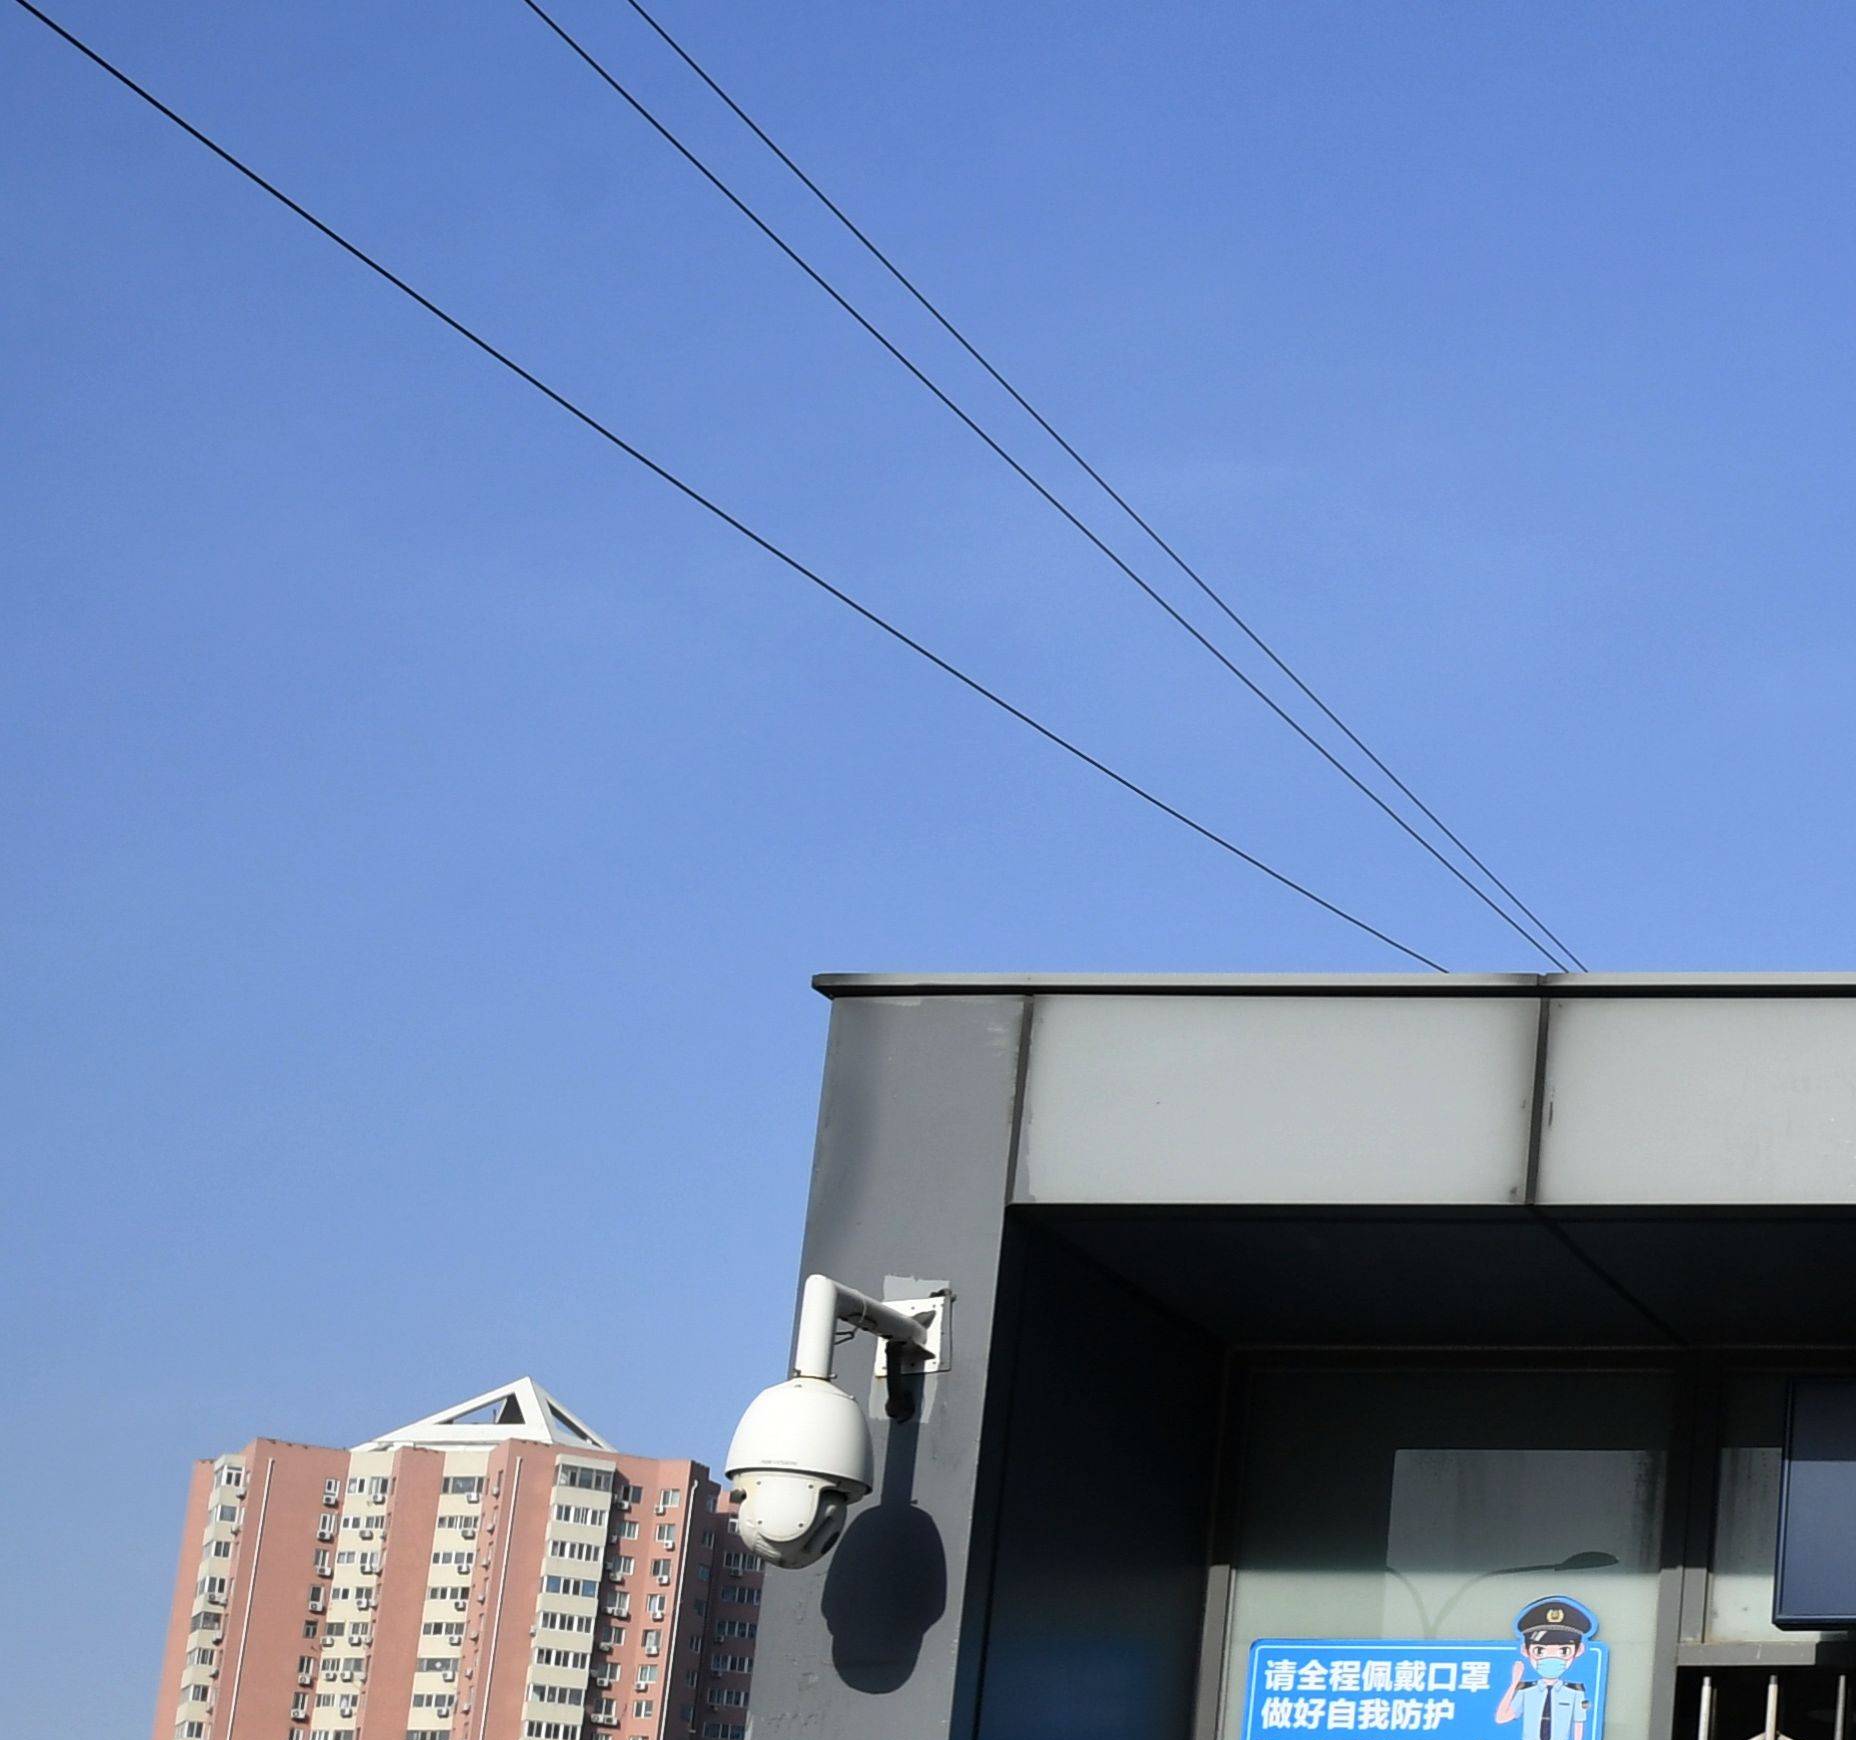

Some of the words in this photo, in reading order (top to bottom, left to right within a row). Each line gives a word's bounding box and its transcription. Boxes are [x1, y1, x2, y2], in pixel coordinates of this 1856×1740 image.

[1263, 1659, 1491, 1694] 请全程佩戴口罩
[1260, 1697, 1456, 1731] 做好自我防护
